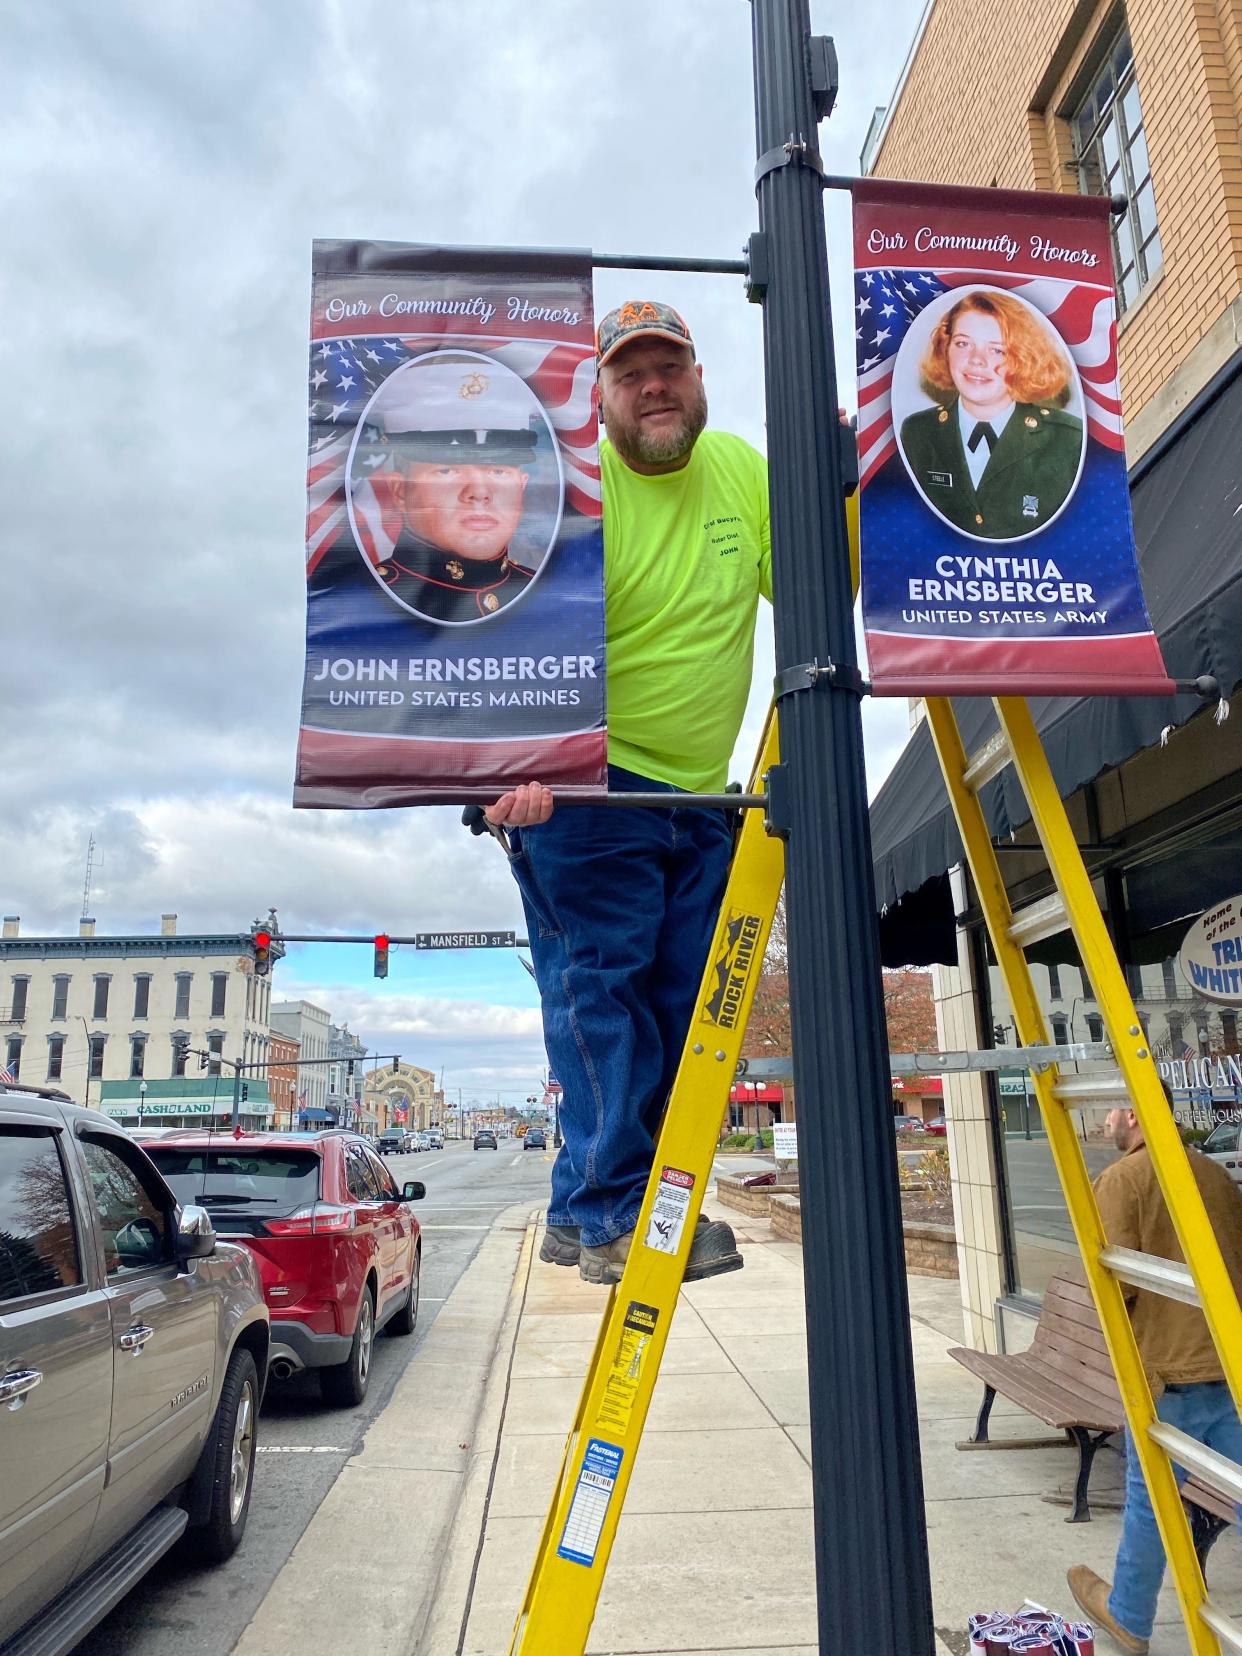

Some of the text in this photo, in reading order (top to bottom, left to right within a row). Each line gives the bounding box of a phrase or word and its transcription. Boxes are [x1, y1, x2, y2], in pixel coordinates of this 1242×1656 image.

[867, 227, 1100, 267] Our Community Honors
[326, 293, 582, 326] Our Community Honors
[720, 546, 739, 556] JOHN
[935, 555, 1063, 580] CYNTHIA
[908, 578, 1096, 604] ERNSBERGER
[902, 609, 1109, 624] UNITED STATES ARMY
[313, 655, 597, 681] JOHN ERNSBERGER
[329, 689, 580, 707] UNITED STATES MARINES
[1203, 903, 1232, 929] Home
[1206, 916, 1236, 941] of the
[430, 934, 487, 947] MANSFIELD
[492, 936, 501, 945] ST
[718, 915, 761, 1029] ROCK RIVER
[1188, 960, 1242, 994] WHIT
[1160, 1053, 1242, 1090] PELICAN
[1173, 1108, 1242, 1123] OFFEE HOUS
[590, 1443, 620, 1459] FASTENAL
